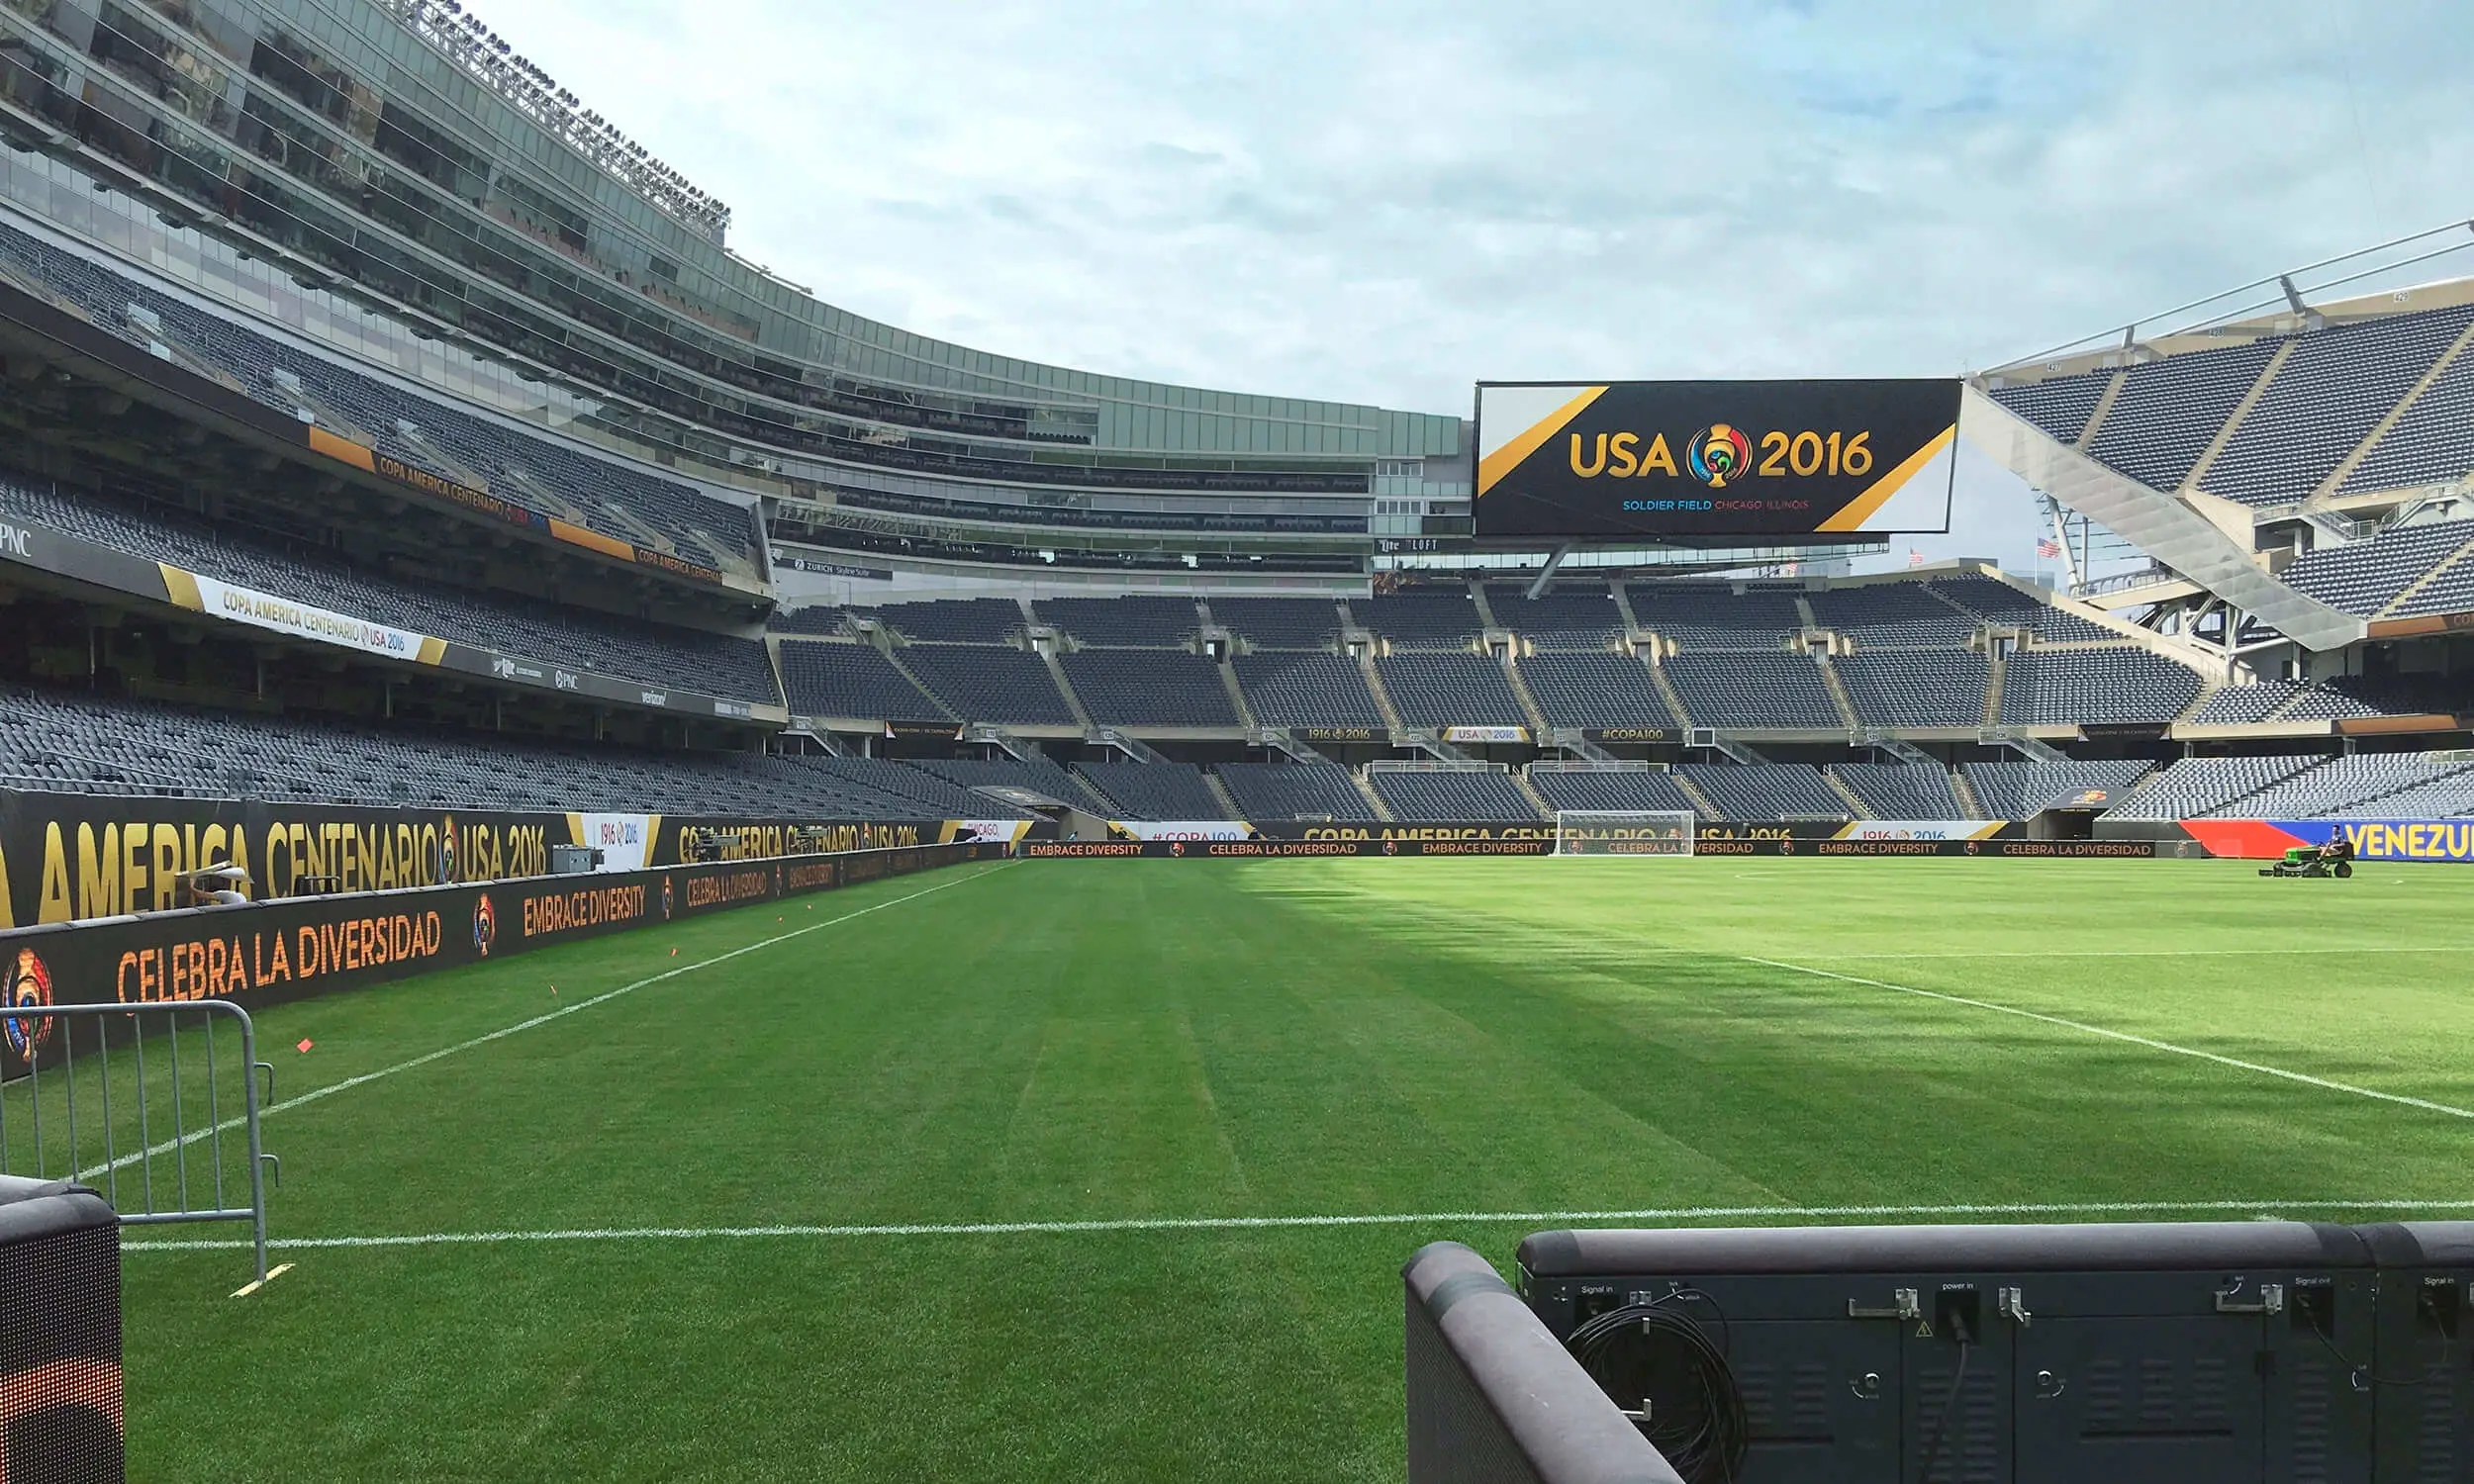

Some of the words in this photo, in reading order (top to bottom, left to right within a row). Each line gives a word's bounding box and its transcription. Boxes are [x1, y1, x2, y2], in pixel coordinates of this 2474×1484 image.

[1570, 431, 1678, 478] USA
[1758, 430, 1872, 478] 2016
[380, 457, 406, 481] COPA
[408, 470, 448, 497] AMERICA
[451, 484, 505, 516] CENTENARIO
[1623, 501, 1674, 510] SOLDIER
[1677, 501, 1712, 510] FIELD
[1714, 501, 1762, 510] CHICAGO
[1766, 500, 1809, 510] ILLINOIS
[0, 522, 32, 557] PNC
[1412, 539, 1437, 551] LOFT
[807, 562, 832, 573] ZURICH
[224, 591, 252, 616] COPA
[254, 602, 301, 627] AMERICA
[304, 611, 359, 641] CENTENARIO
[370, 630, 387, 646] USA
[388, 633, 405, 651] 2016
[1308, 729, 1330, 740] 1916
[1346, 729, 1370, 740] 2016
[1459, 730, 1479, 740] USA
[1493, 730, 1515, 740] 2016
[1601, 729, 1664, 740] #COPA100
[601, 823, 616, 845] 1916
[624, 823, 638, 845] 2016
[1862, 830, 1891, 840] 1916
[1914, 830, 1946, 840] 2016
[720, 825, 782, 861] AMERICA
[2344, 824, 2474, 858] VENEZU
[1030, 845, 1084, 856] EMBRACE
[1086, 845, 1143, 856] DIVERSITY
[1210, 844, 1262, 856] CELEBRA
[1265, 844, 1282, 855] LA
[1284, 844, 1357, 855] DIVERSIDAD
[1422, 844, 1479, 854] EMBRACE
[1482, 843, 1542, 854] DIVERSITY
[1608, 843, 1660, 854] CELEBRA
[1663, 843, 1678, 854] LA
[1681, 843, 1754, 854] DVERSIDAD
[1819, 843, 1876, 854] EMBRACE
[1879, 843, 1938, 854] DIVERSITY
[2003, 844, 2055, 855] CELEBRA
[2058, 844, 2073, 855] LA
[2075, 844, 2150, 856] DIVERSIDAD
[38, 821, 253, 927] AMERICA
[266, 821, 436, 898] CENTENARIO
[462, 823, 503, 883] USA
[509, 824, 546, 878] 2016
[687, 876, 720, 907] CELEBRA
[523, 892, 588, 937] EMBRACE
[590, 883, 646, 924] DIVERSITY
[118, 935, 248, 1017] CELEBRA
[254, 929, 292, 987] LA
[299, 910, 441, 979] DIVERSIDAD
[1581, 1286, 1604, 1295] Signal
